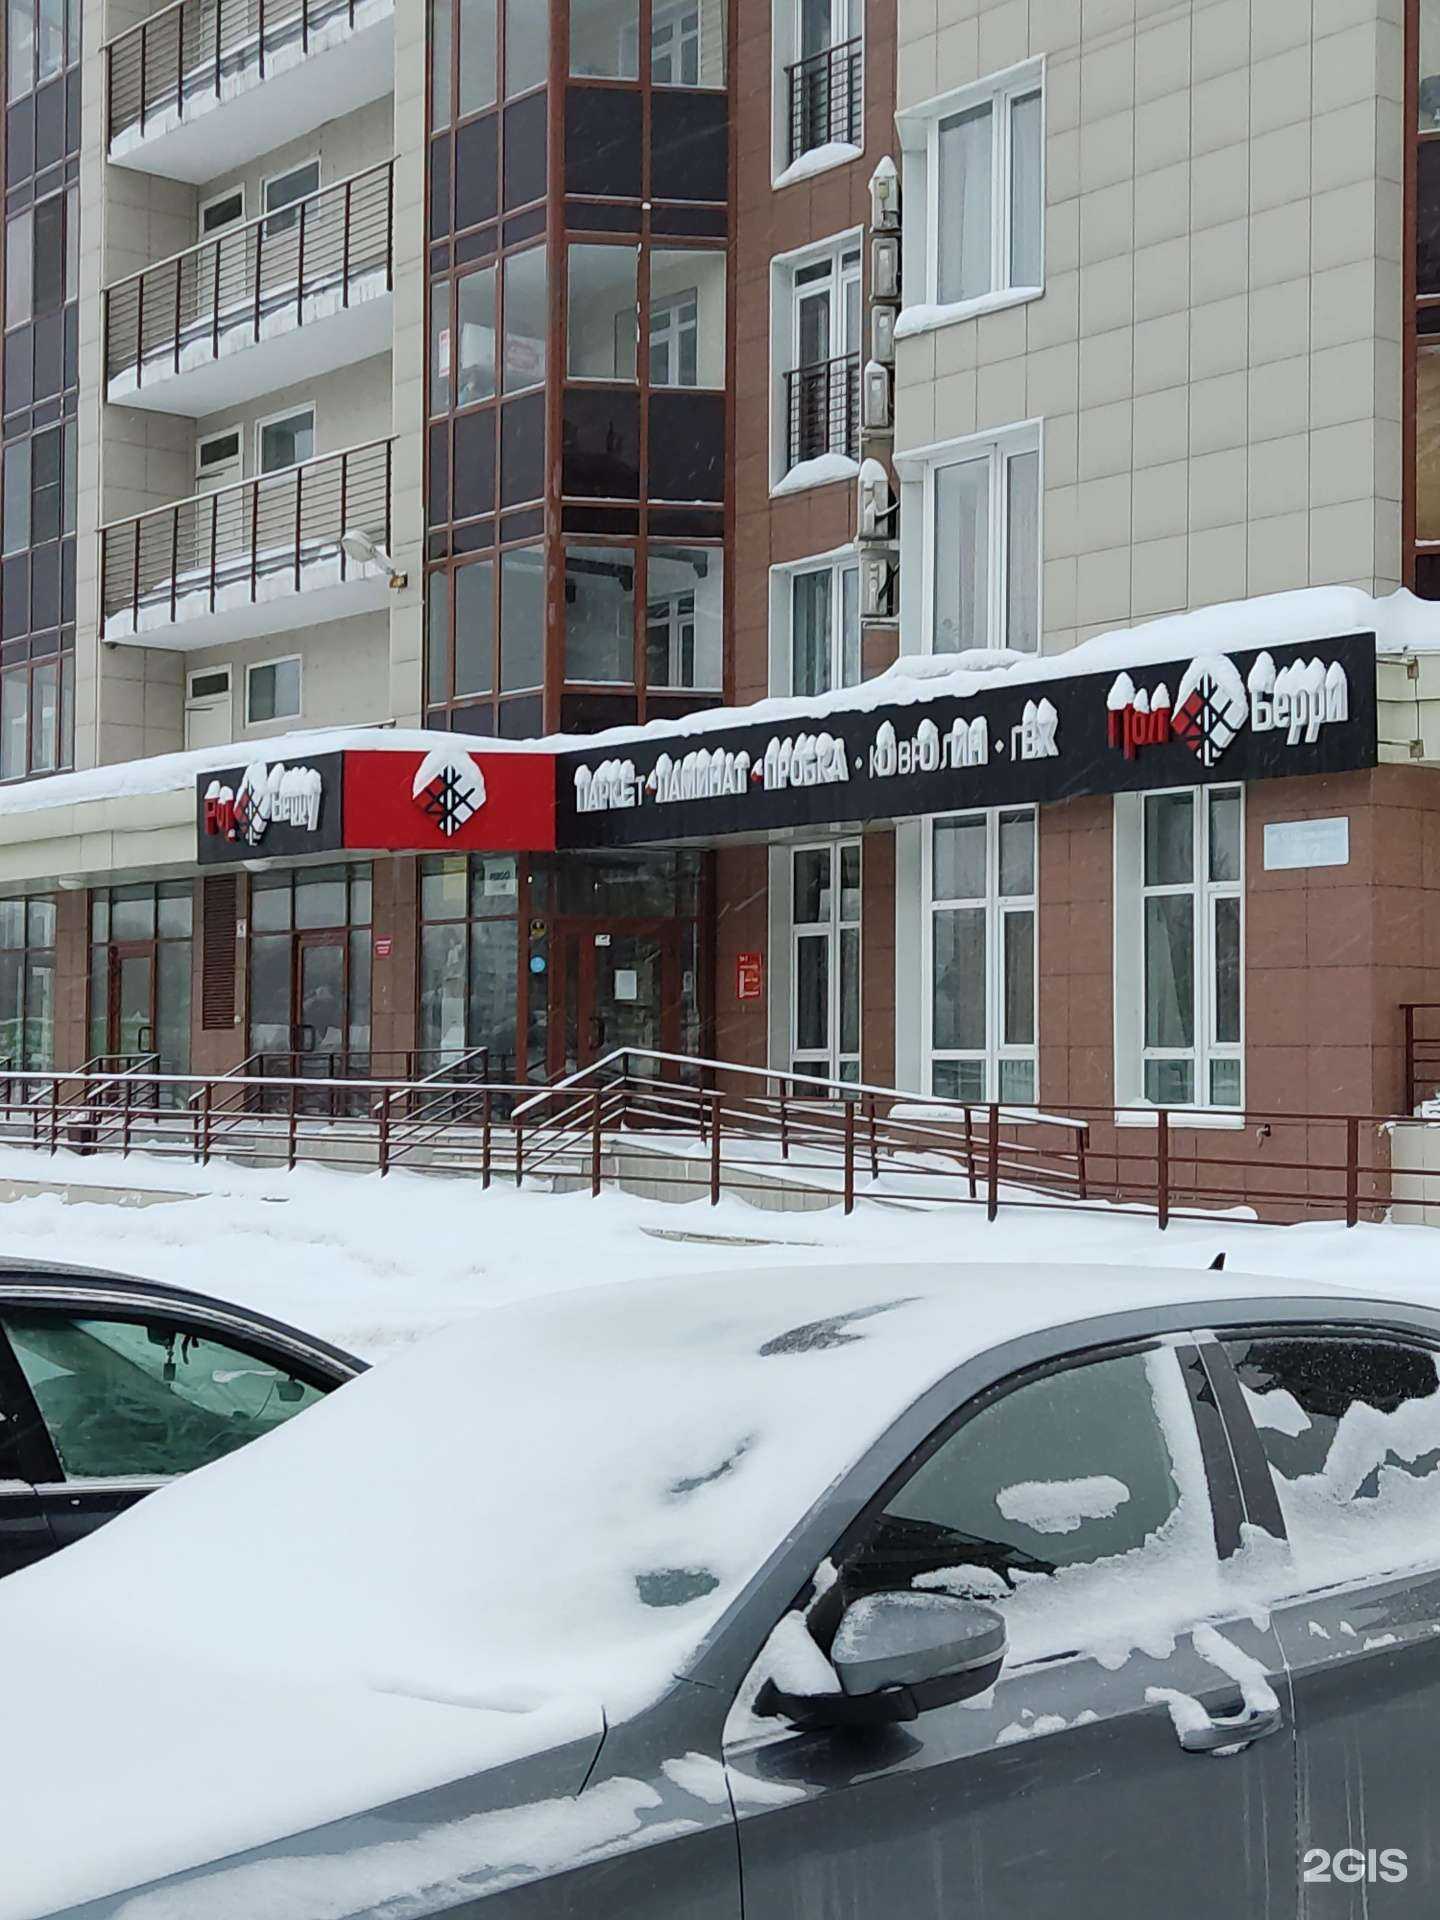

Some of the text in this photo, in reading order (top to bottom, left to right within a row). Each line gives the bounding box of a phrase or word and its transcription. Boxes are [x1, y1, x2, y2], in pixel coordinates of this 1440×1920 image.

[574, 703, 1059, 813] ПАРКЕТ ЛАМИНАТ ПРОБКА КОВРОЛИН ПВХ
